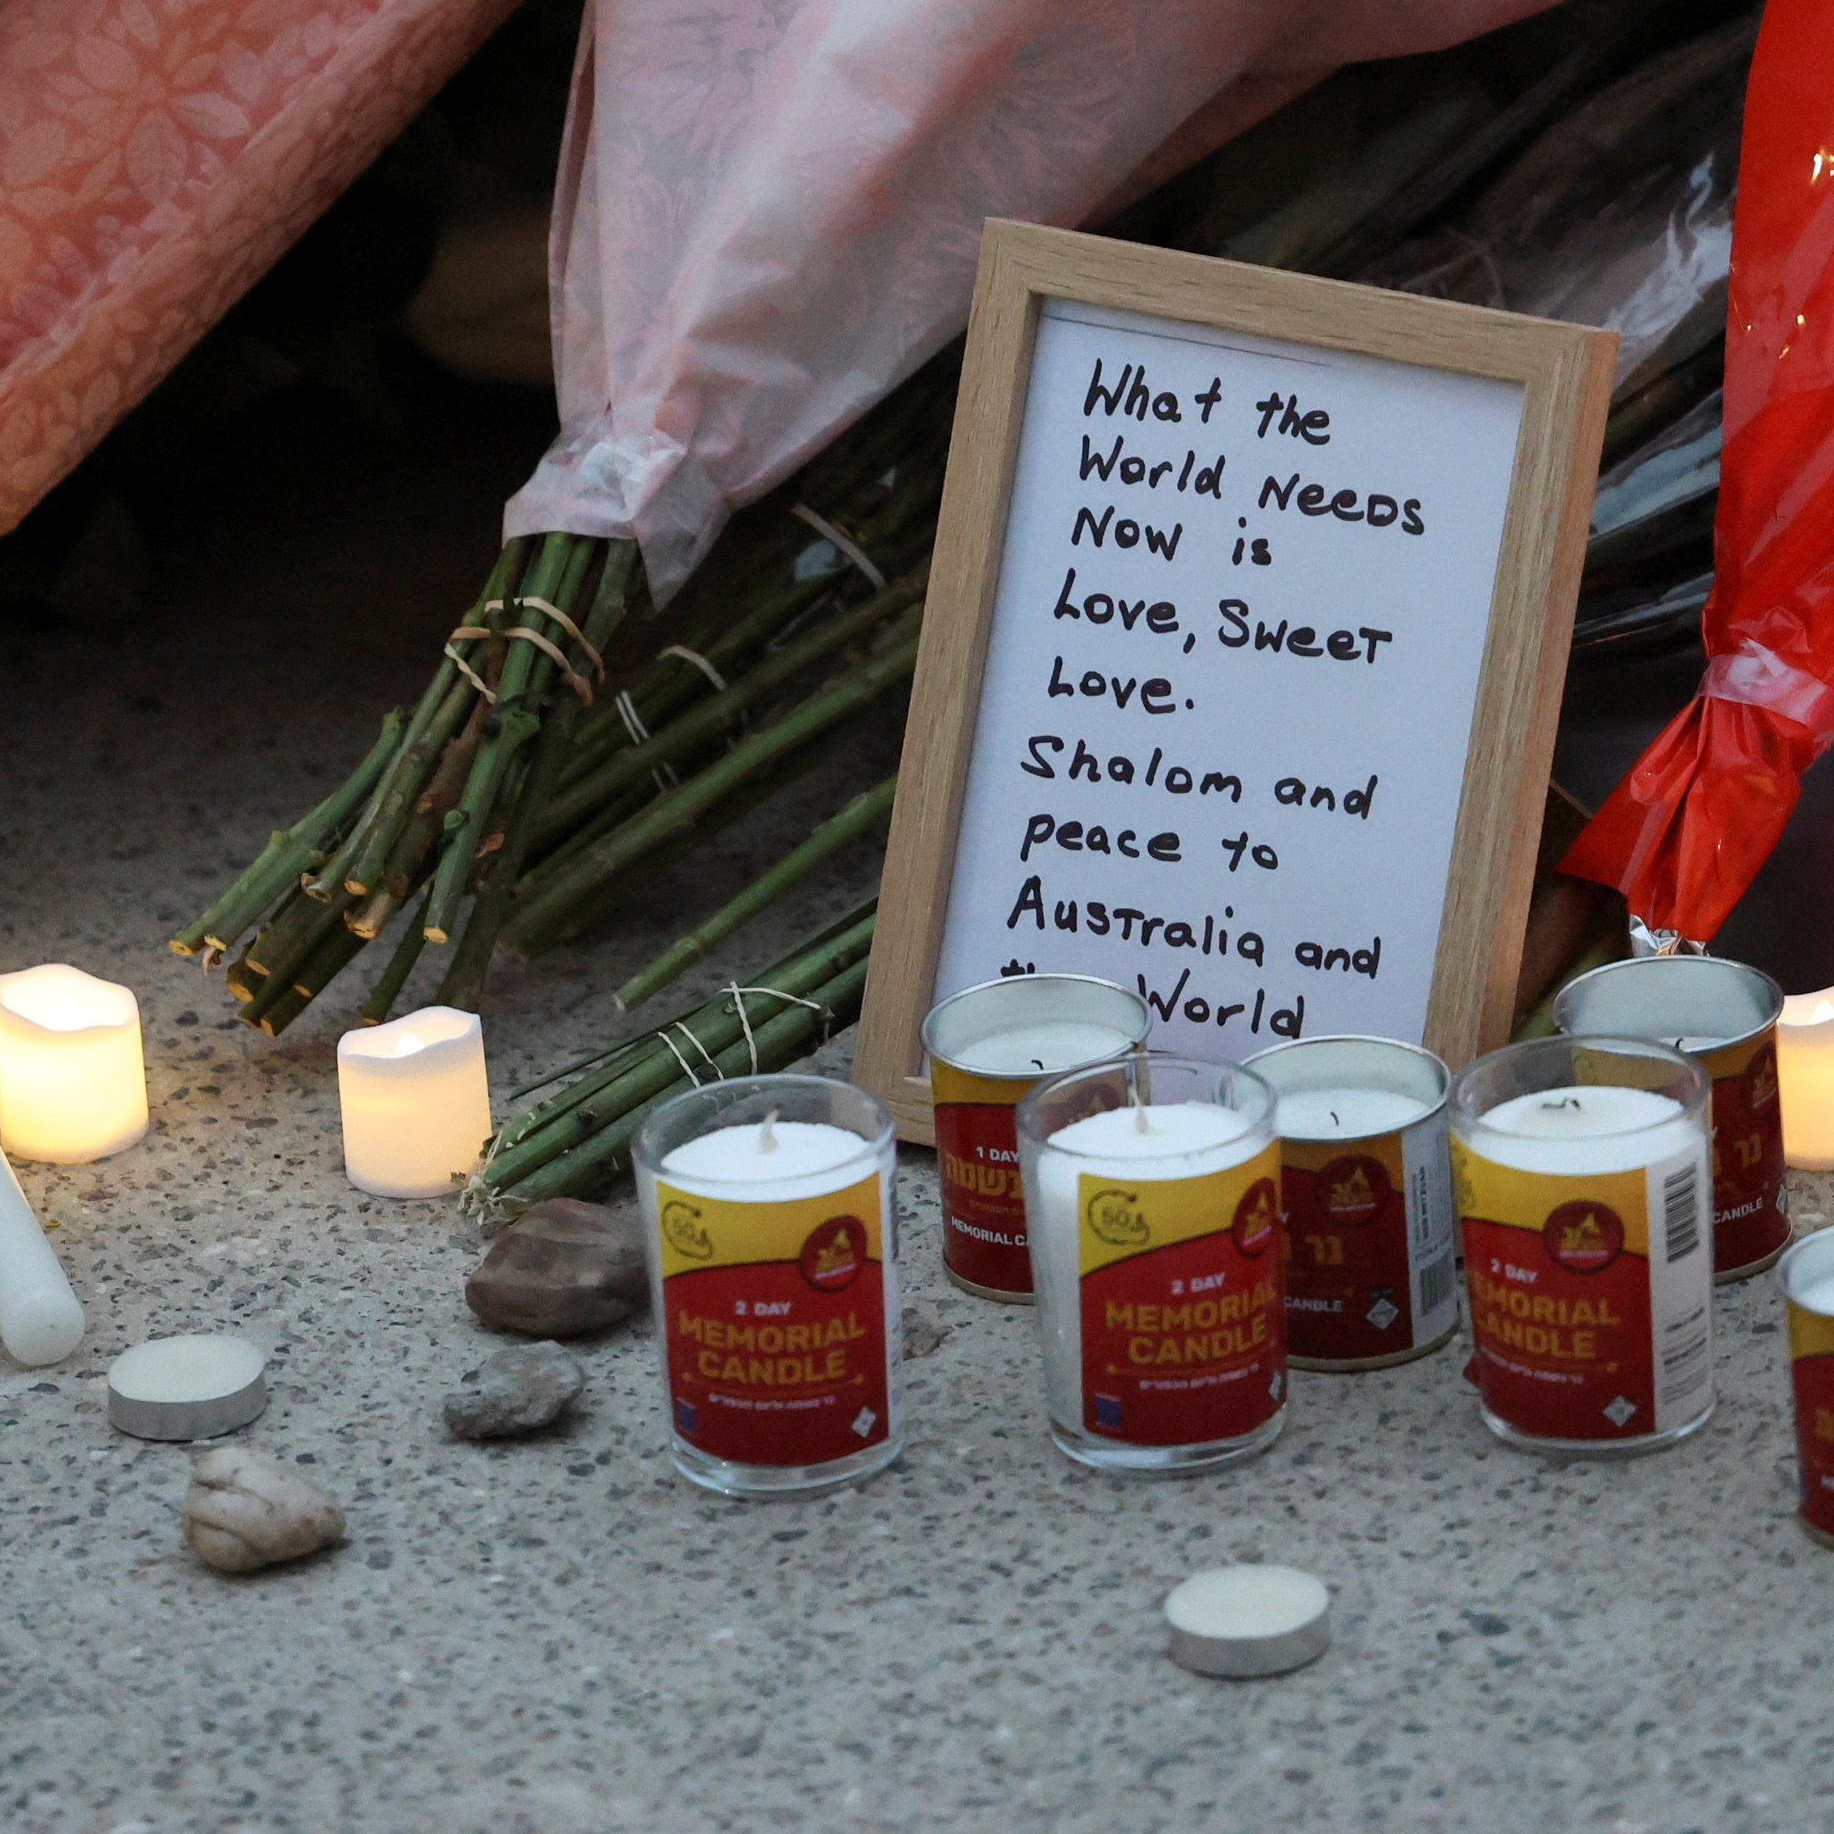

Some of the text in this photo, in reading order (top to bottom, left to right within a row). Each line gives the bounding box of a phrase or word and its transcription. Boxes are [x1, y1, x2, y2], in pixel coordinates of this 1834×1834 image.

[1083, 357, 1332, 446] What the
[1079, 434, 1226, 500] World
[1231, 516, 1273, 566] is
[1053, 567, 1196, 654] Love,
[1047, 655, 1195, 715] Love.
[1020, 735, 1378, 820] Shalom and
[1019, 813, 1279, 873] peace to
[1294, 936, 1381, 980] and
[1136, 967, 1305, 1040] World
[975, 1146, 1019, 1163] 1 DAY
[951, 1216, 1013, 1246] MEMORIAL
[1171, 1272, 1227, 1295] 2 DAY
[1469, 1269, 1622, 1327] EMORIAL
[1505, 1262, 1539, 1284] DAY
[678, 1308, 866, 1355] MEMORIAL
[734, 1300, 792, 1317] 2 DAY
[1128, 1313, 1268, 1365] CANDLE
[697, 1348, 848, 1386] CANDLE
